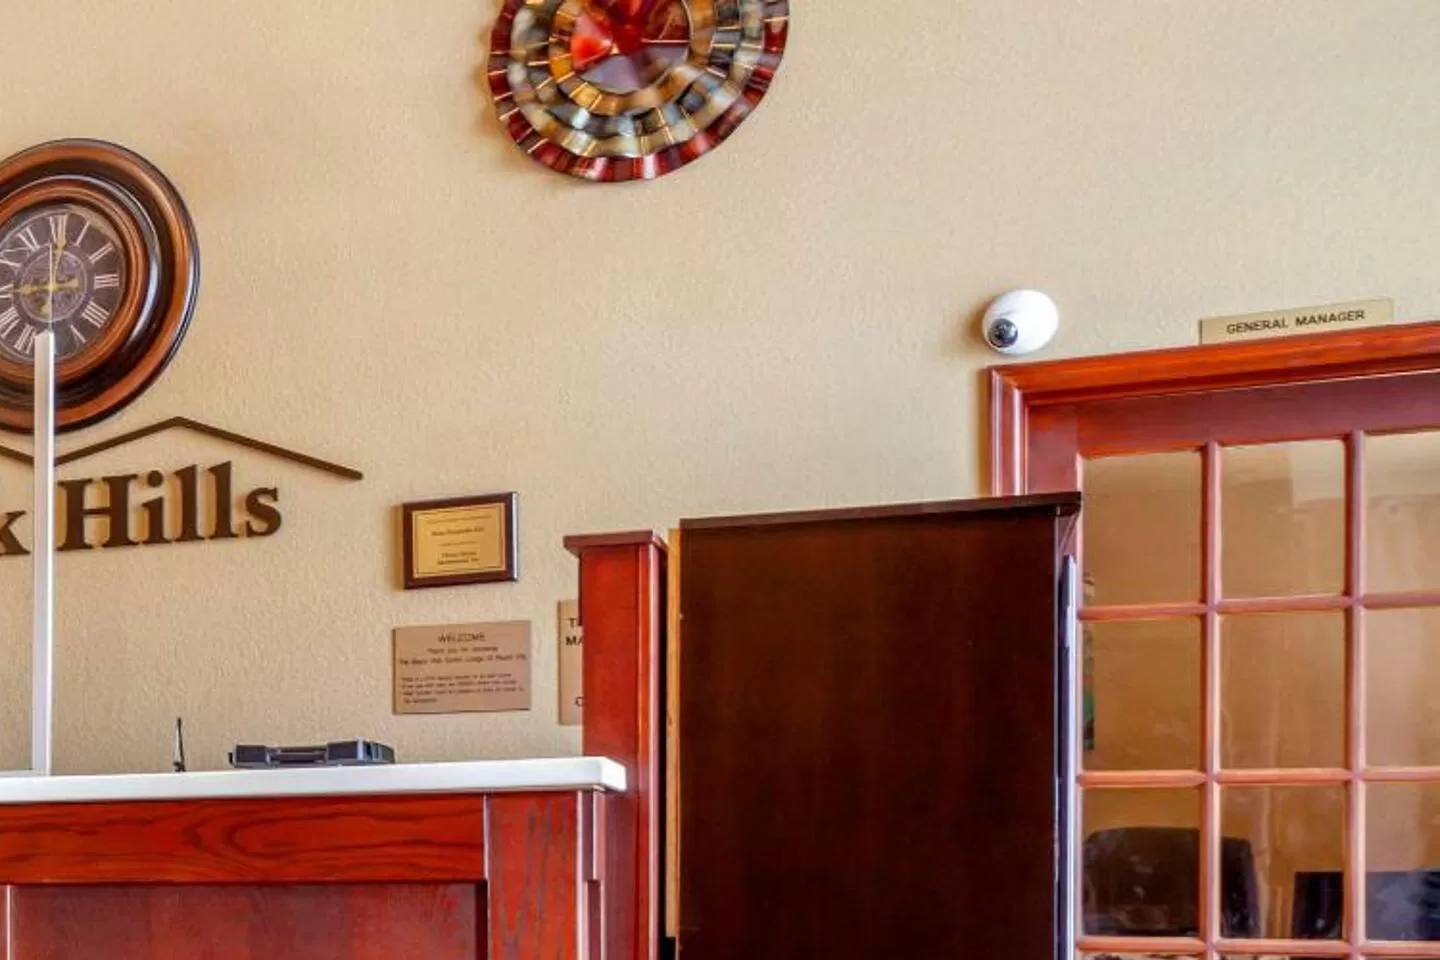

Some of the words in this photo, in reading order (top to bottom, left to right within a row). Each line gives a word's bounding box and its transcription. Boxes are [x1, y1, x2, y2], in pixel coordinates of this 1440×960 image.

[1226, 318, 1289, 334] GENERAL
[1295, 309, 1365, 326] MANAGER
[57, 460, 282, 551] Hills
